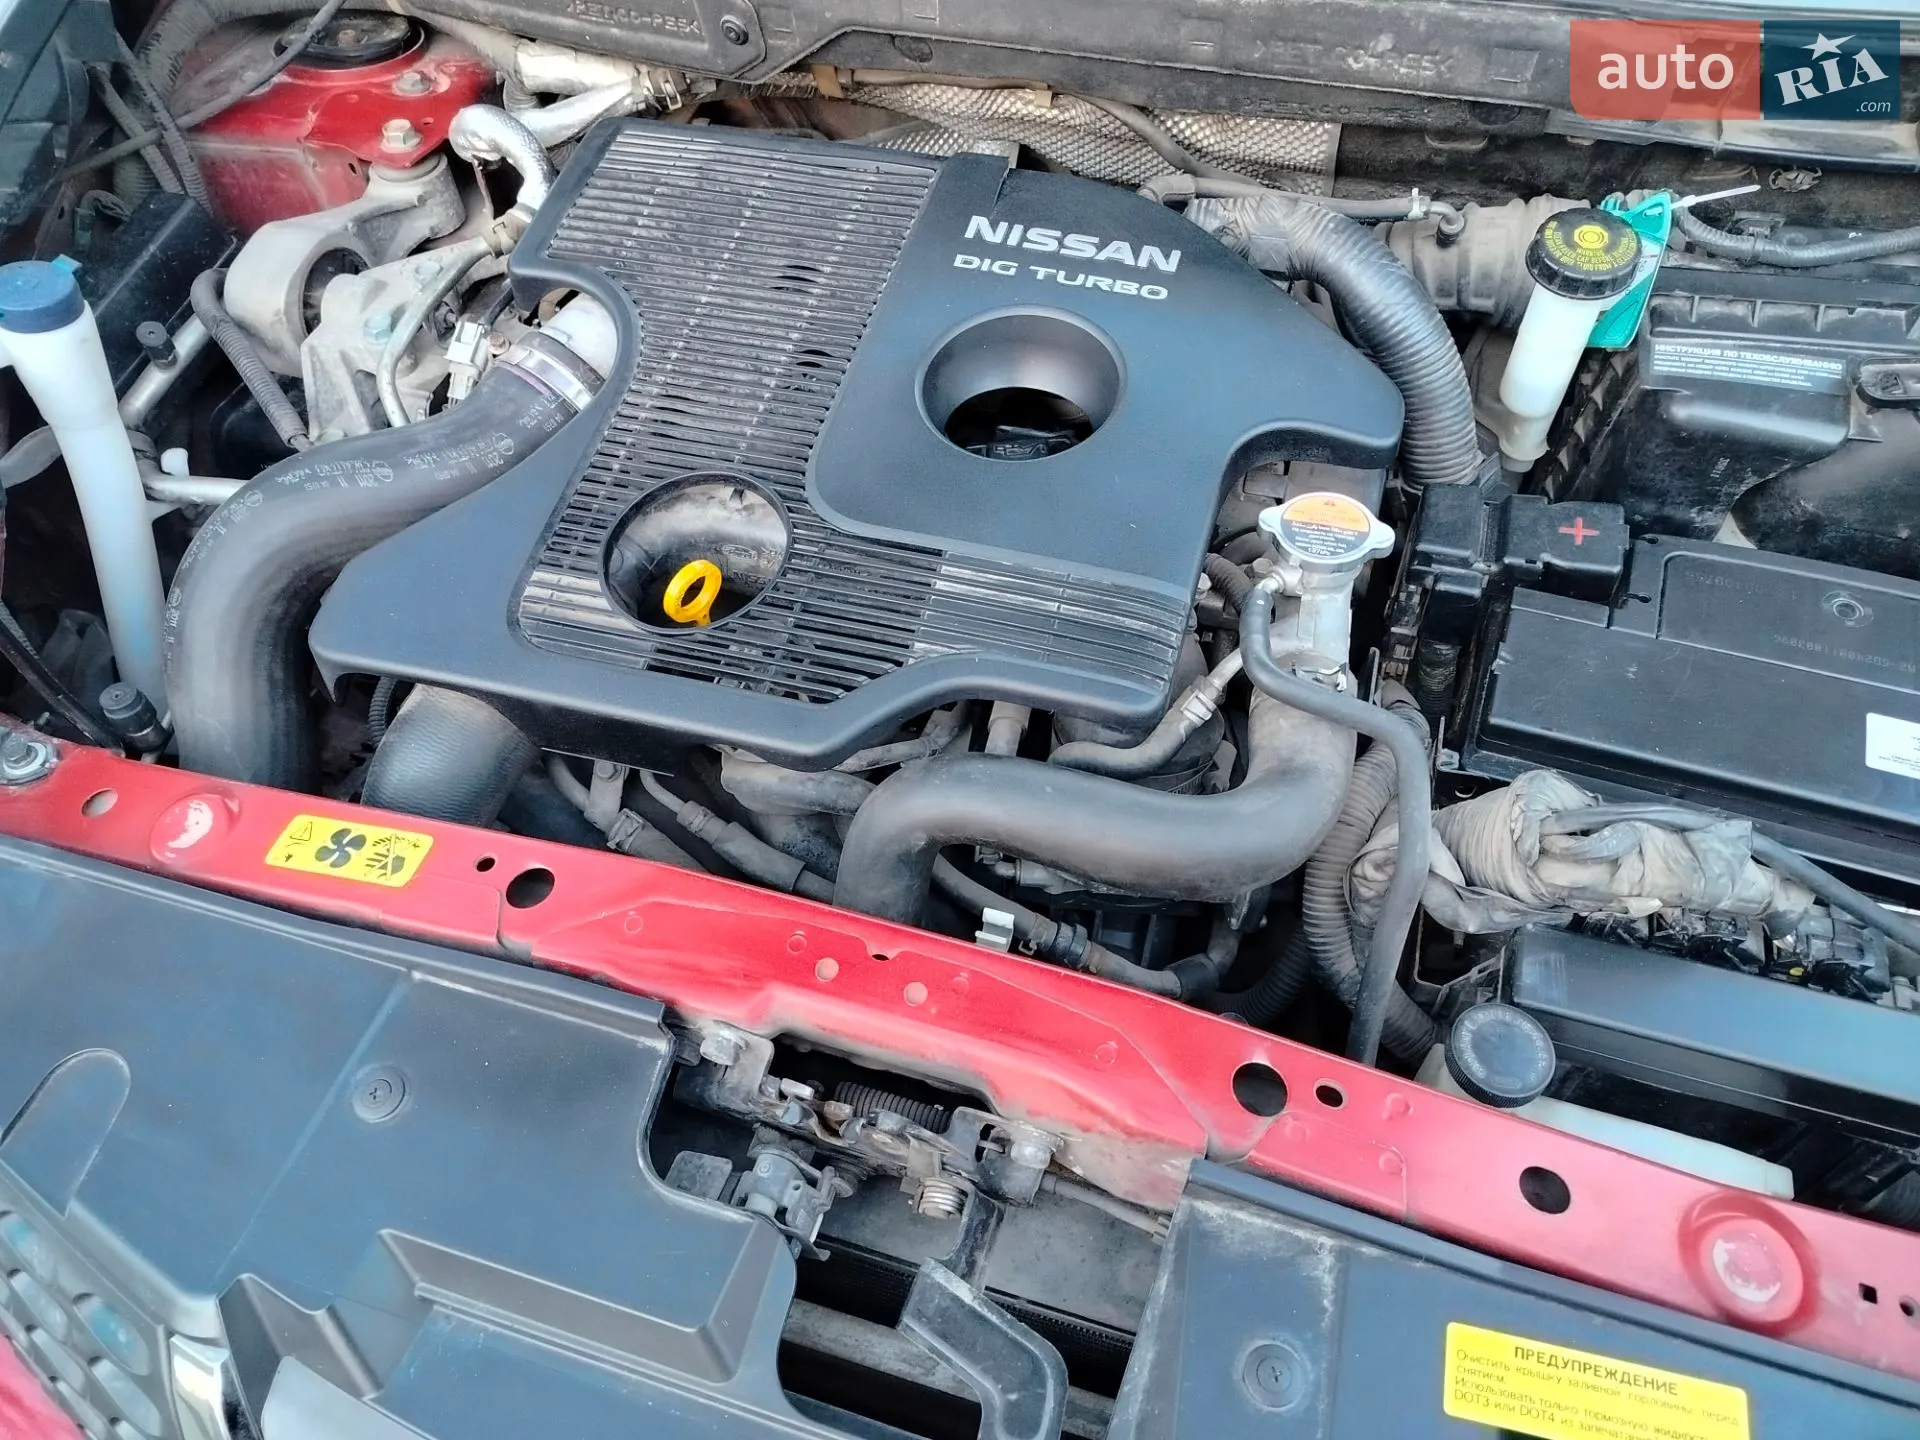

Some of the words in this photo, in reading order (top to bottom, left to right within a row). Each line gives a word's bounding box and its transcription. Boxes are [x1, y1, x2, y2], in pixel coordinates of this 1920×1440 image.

[964, 215, 1182, 273] NISSAN
[953, 254, 1019, 277] DIG
[1029, 265, 1169, 300] TURBO
[1456, 1349, 1511, 1372] Очистить
[1516, 1366, 1562, 1385] крышку
[1568, 1378, 1622, 1397] заливной
[1456, 1365, 1507, 1385] снятием.
[1514, 1346, 1678, 1396] ПРЕДУПРЕЖДЕНИЕ
[1454, 1388, 1490, 1408] DOT3
[1494, 1401, 1516, 1414] или
[1519, 1404, 1555, 1422] DOT4
[1455, 1376, 1536, 1405] Использовать
[1539, 1398, 1579, 1415] только
[1584, 1408, 1648, 1431] тормозную
